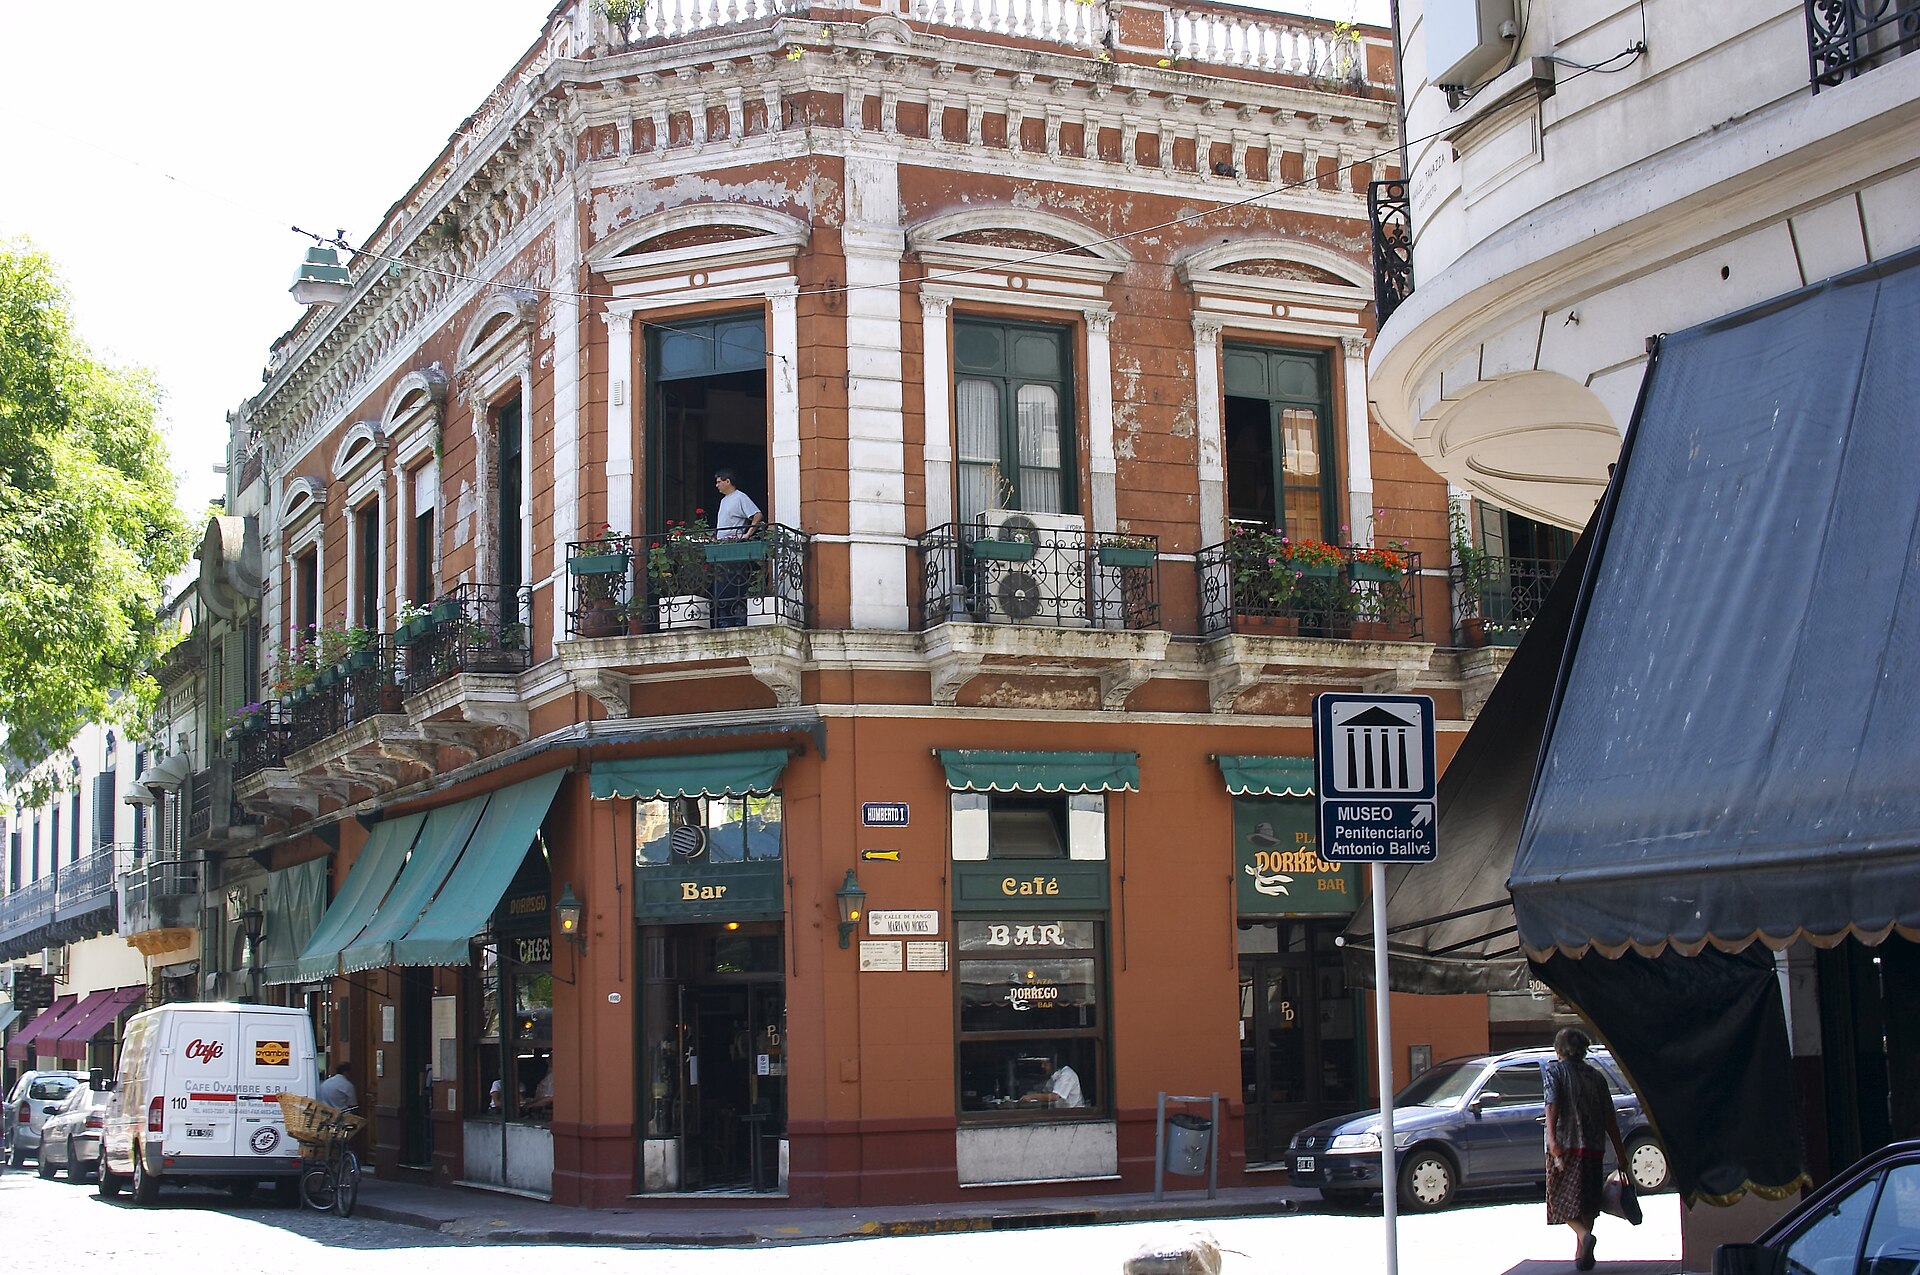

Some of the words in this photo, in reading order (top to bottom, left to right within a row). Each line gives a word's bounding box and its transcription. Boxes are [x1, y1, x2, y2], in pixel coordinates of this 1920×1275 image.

[867, 807, 899, 822] HUMBERTO
[1338, 806, 1393, 821] MUSEO
[1335, 825, 1424, 839] Penitenciario
[1331, 842, 1385, 855] Antonio
[1389, 841, 1431, 855] Ballvé
[680, 882, 727, 900] Bar
[1001, 877, 1059, 896] Café
[1318, 878, 1347, 895] BAR
[510, 895, 547, 914] DORREGO
[887, 920, 910, 932] MARIANO
[986, 925, 1065, 946] BAR
[1010, 986, 1058, 999] DORREGO
[185, 1039, 224, 1064] Café
[171, 1097, 188, 1110] 110
